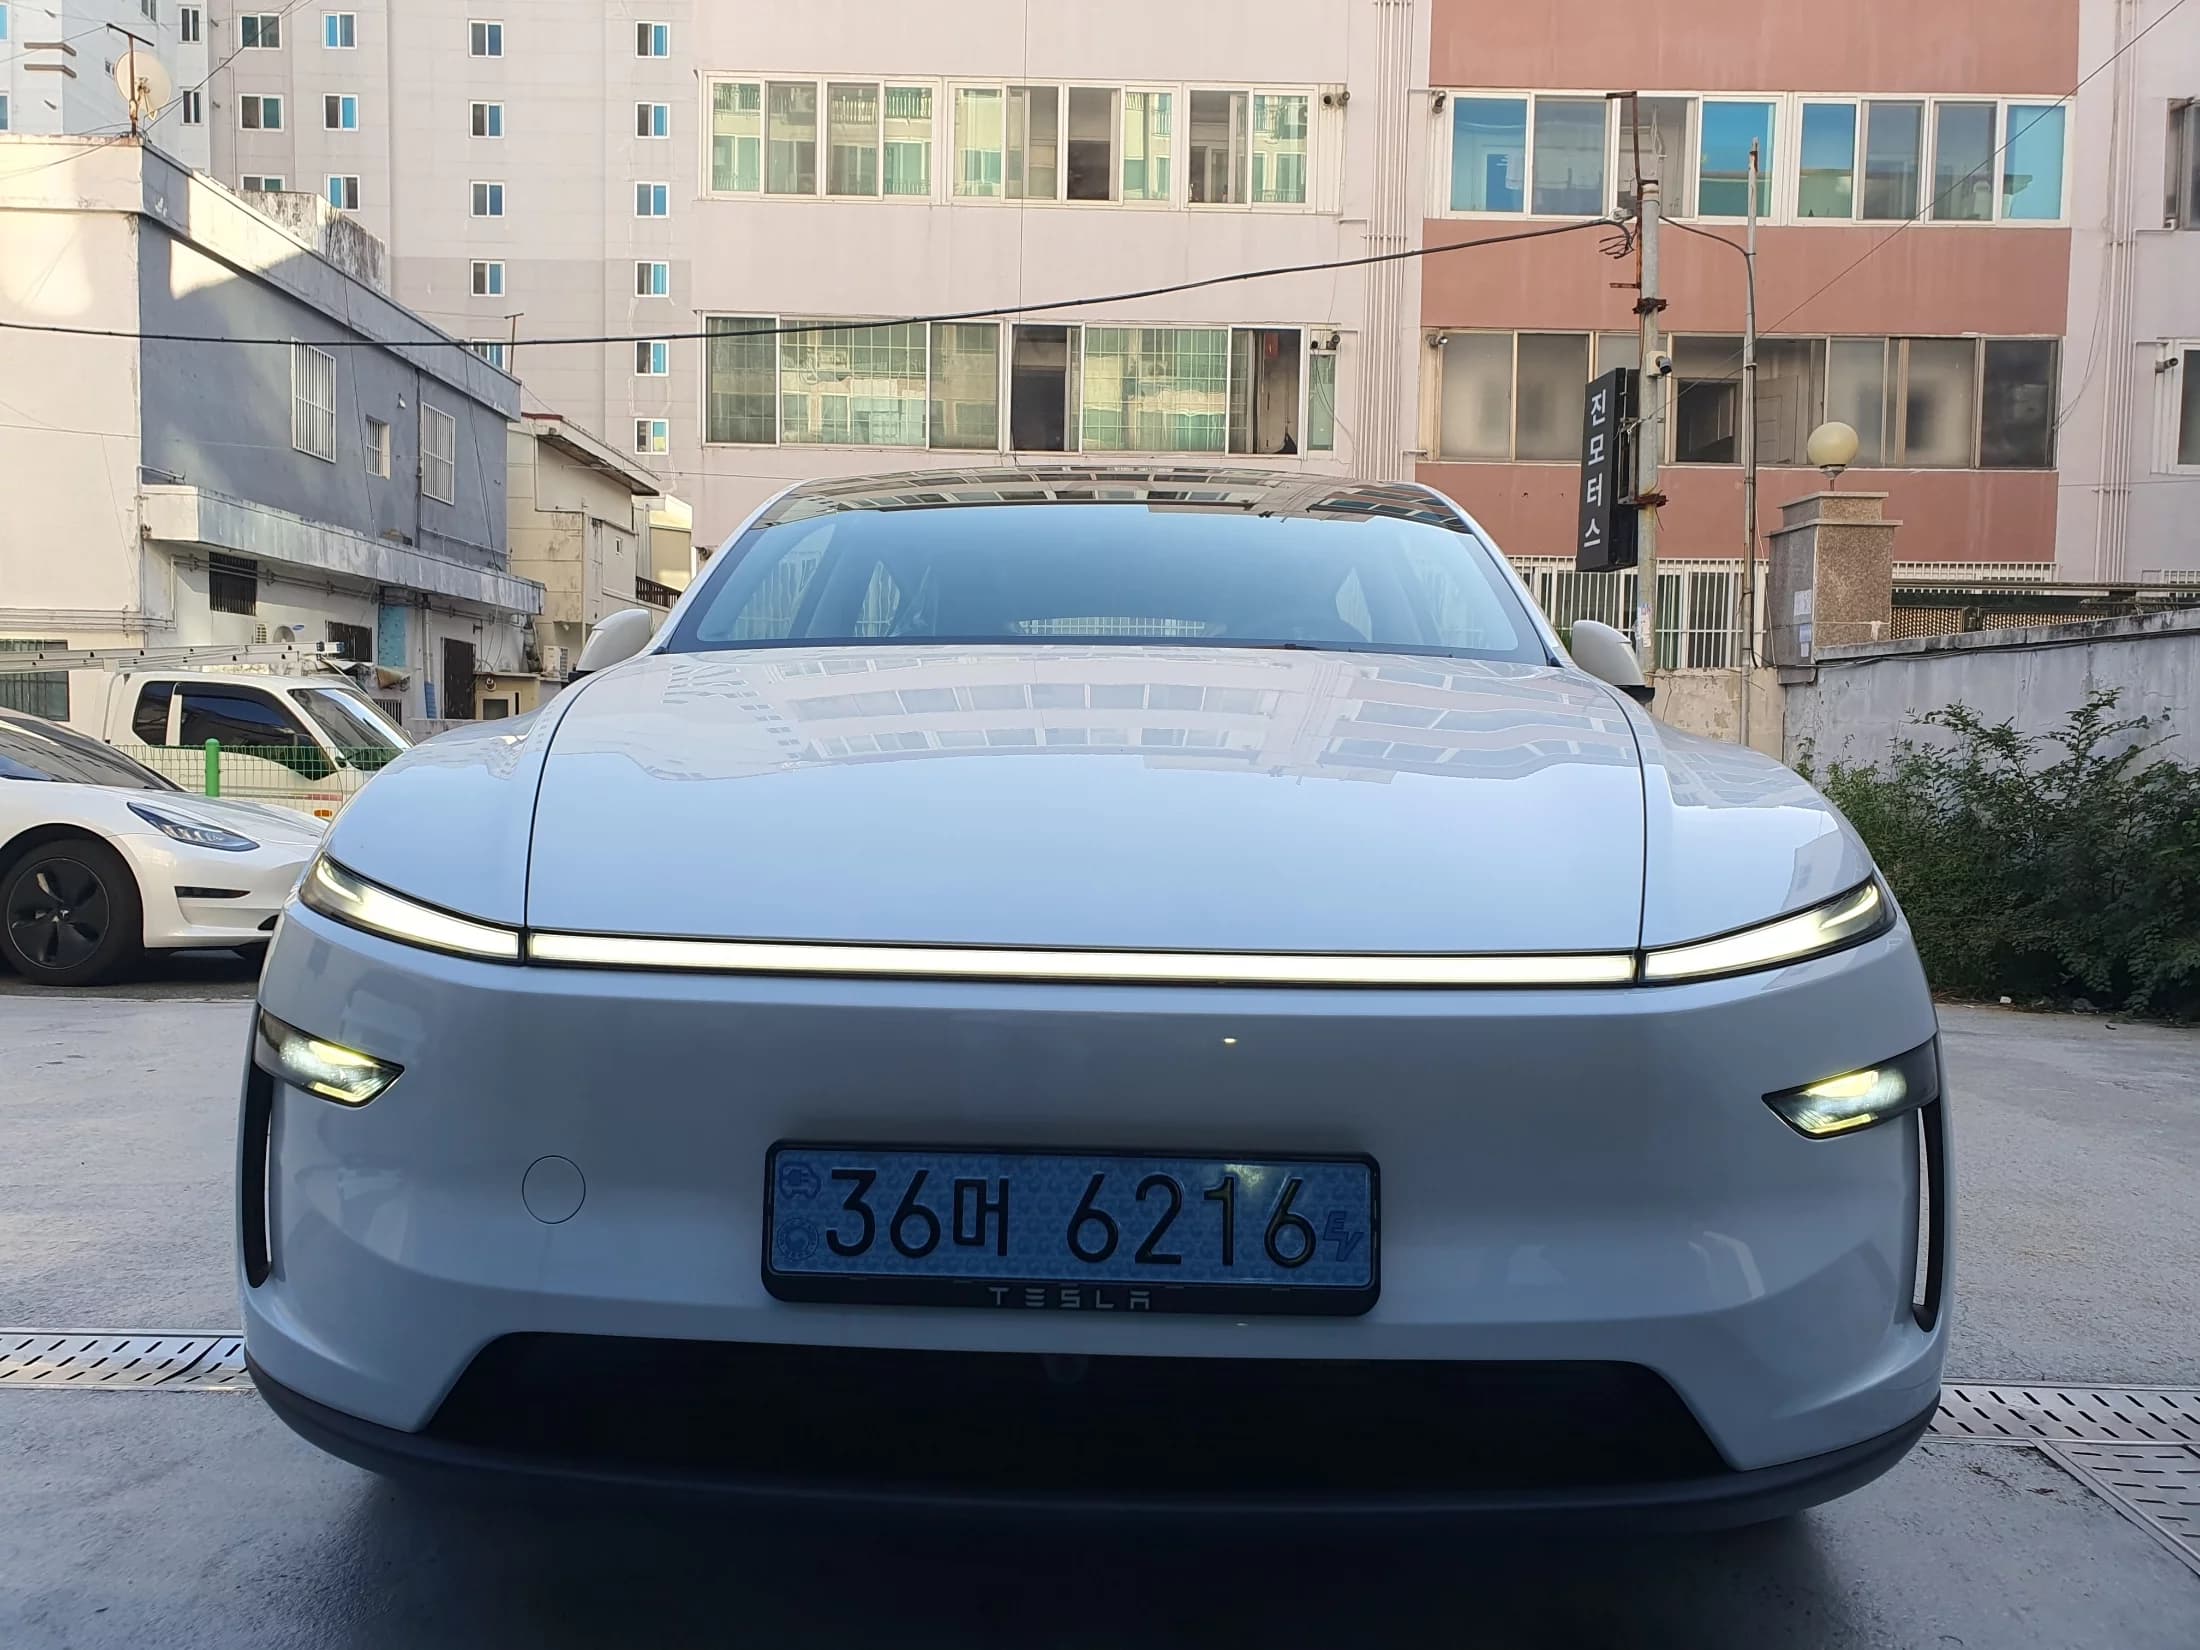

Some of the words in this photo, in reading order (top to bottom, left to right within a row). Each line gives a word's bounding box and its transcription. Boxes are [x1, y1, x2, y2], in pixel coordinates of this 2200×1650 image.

[1584, 389, 1606, 548] 진모터스
[825, 1168, 1009, 1259] 36머
[1067, 1173, 1316, 1268] 6216
[1323, 1210, 1364, 1262] EV
[988, 1287, 1150, 1310] TESLA
